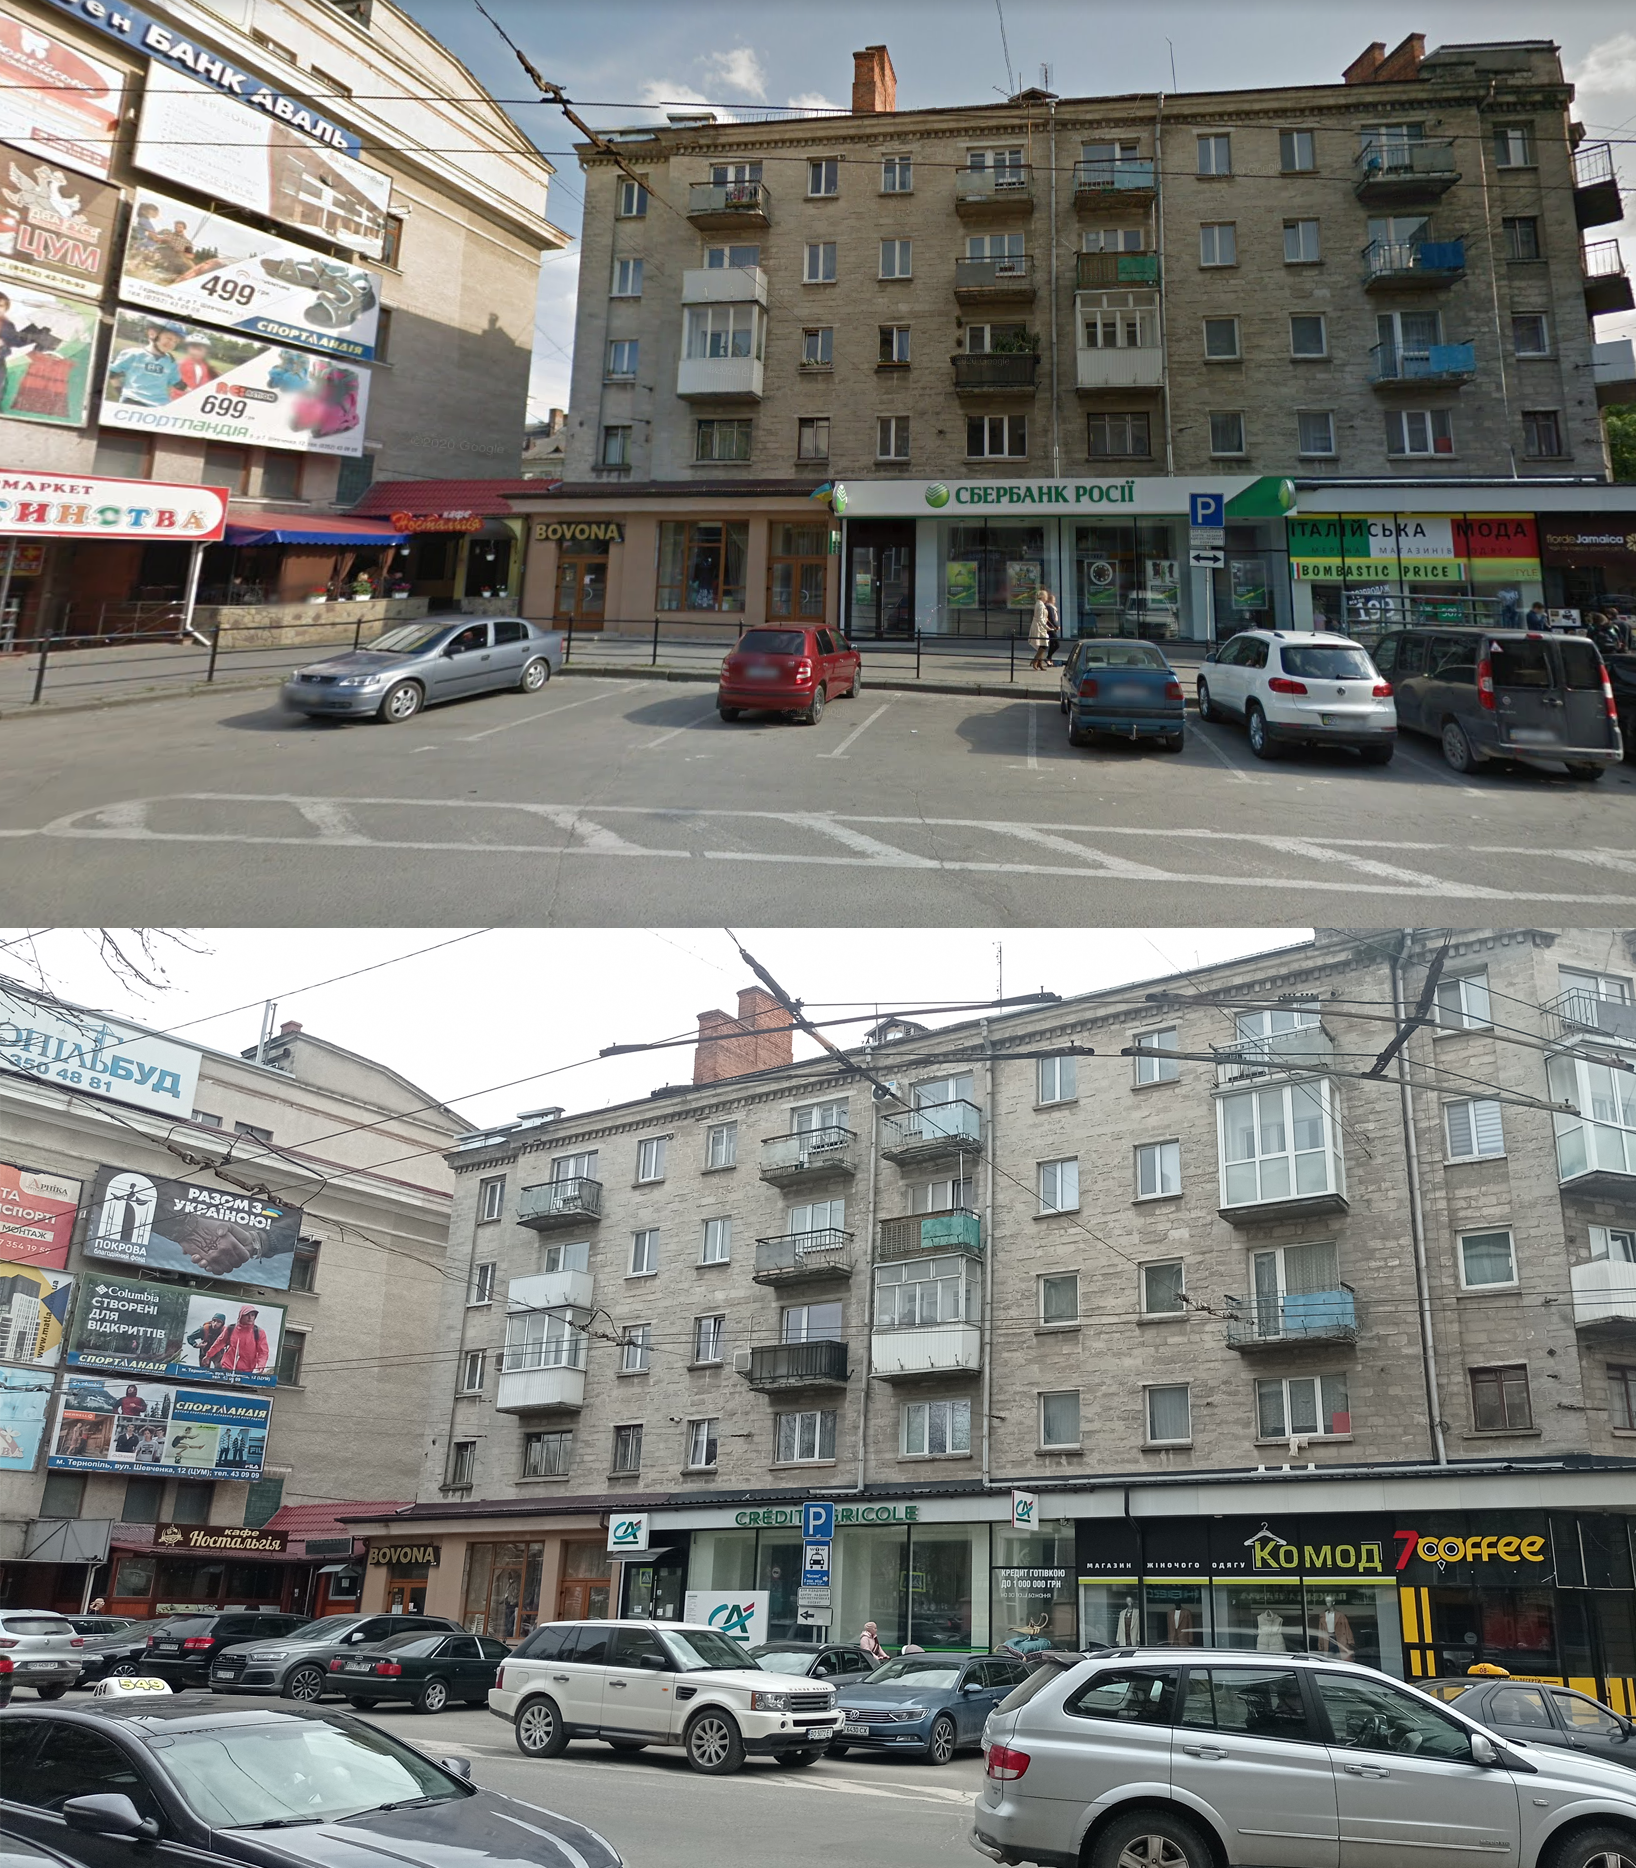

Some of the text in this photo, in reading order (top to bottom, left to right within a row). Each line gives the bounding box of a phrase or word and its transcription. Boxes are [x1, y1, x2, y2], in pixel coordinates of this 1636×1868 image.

[59, 0, 131, 32] ен
[144, 24, 248, 94] БАНК
[250, 88, 349, 150] АВАЛЬ
[17, 224, 101, 272] ЦУМ
[200, 275, 255, 306] 499
[256, 319, 363, 355] СПОРТЛАНДІЯ
[200, 394, 247, 420] 699
[0, 480, 94, 495] МАРКЕТ
[955, 480, 1135, 505] СБЕРБАНК РОСІЇ
[0, 499, 209, 531] ИНСТВА
[394, 512, 483, 532] Ностальгія
[535, 523, 621, 541] BOVONA
[1291, 519, 1528, 540] ІТАЛІЙСЬКА МОДА
[1378, 547, 1453, 555] МАГАЗИНІВ
[1302, 565, 1449, 578] BOMBASTIC PRICE
[1511, 567, 1539, 577] TYLE
[9, 1053, 112, 1093] 350 48 81
[1, 1187, 20, 1202] ТА
[187, 1187, 249, 1211] РАЗОМ
[0, 1203, 57, 1224] СПОРТІ
[173, 1198, 272, 1230] УКРАЇНОЮ!
[2, 1224, 47, 1239] МОНТАЖ
[6, 1240, 24, 1250] 354
[27, 1244, 37, 1252] 19
[94, 1239, 147, 1256] ПОКРОВА
[130, 1254, 146, 1263] фонд
[108, 1286, 160, 1303] Columbia
[89, 1308, 119, 1321] ДЛЯ
[91, 1297, 158, 1315] СТВОРЕНІ
[87, 1320, 166, 1339] ВІДКРИТТІВ
[79, 1354, 168, 1371] СПОРТЛАНДІЯ
[176, 1401, 267, 1418] СПОРТЛАНДІЯ
[68, 1459, 113, 1470] Тернопіль,
[114, 1463, 132, 1471] вул.
[133, 1464, 175, 1473] Шевченка,
[240, 1471, 250, 1479] 09
[735, 1507, 803, 1527] CRÉDIT
[808, 1506, 827, 1536] P
[189, 1530, 281, 1551] Ностальгія
[224, 1529, 260, 1537] кафе
[369, 1546, 436, 1565] BOVONA
[1001, 1569, 1066, 1578] КРЕДИТ ГОТІВКОЮ
[1086, 1562, 1132, 1570] МАГАЗИН
[1211, 1561, 1246, 1570] ОДЯГУ
[1001, 1580, 1011, 1589] ДО
[1018, 1580, 1031, 1588] 000
[1032, 1580, 1046, 1588] 000
[1047, 1580, 1061, 1588] ГРН
[118, 1678, 165, 1690] 549
